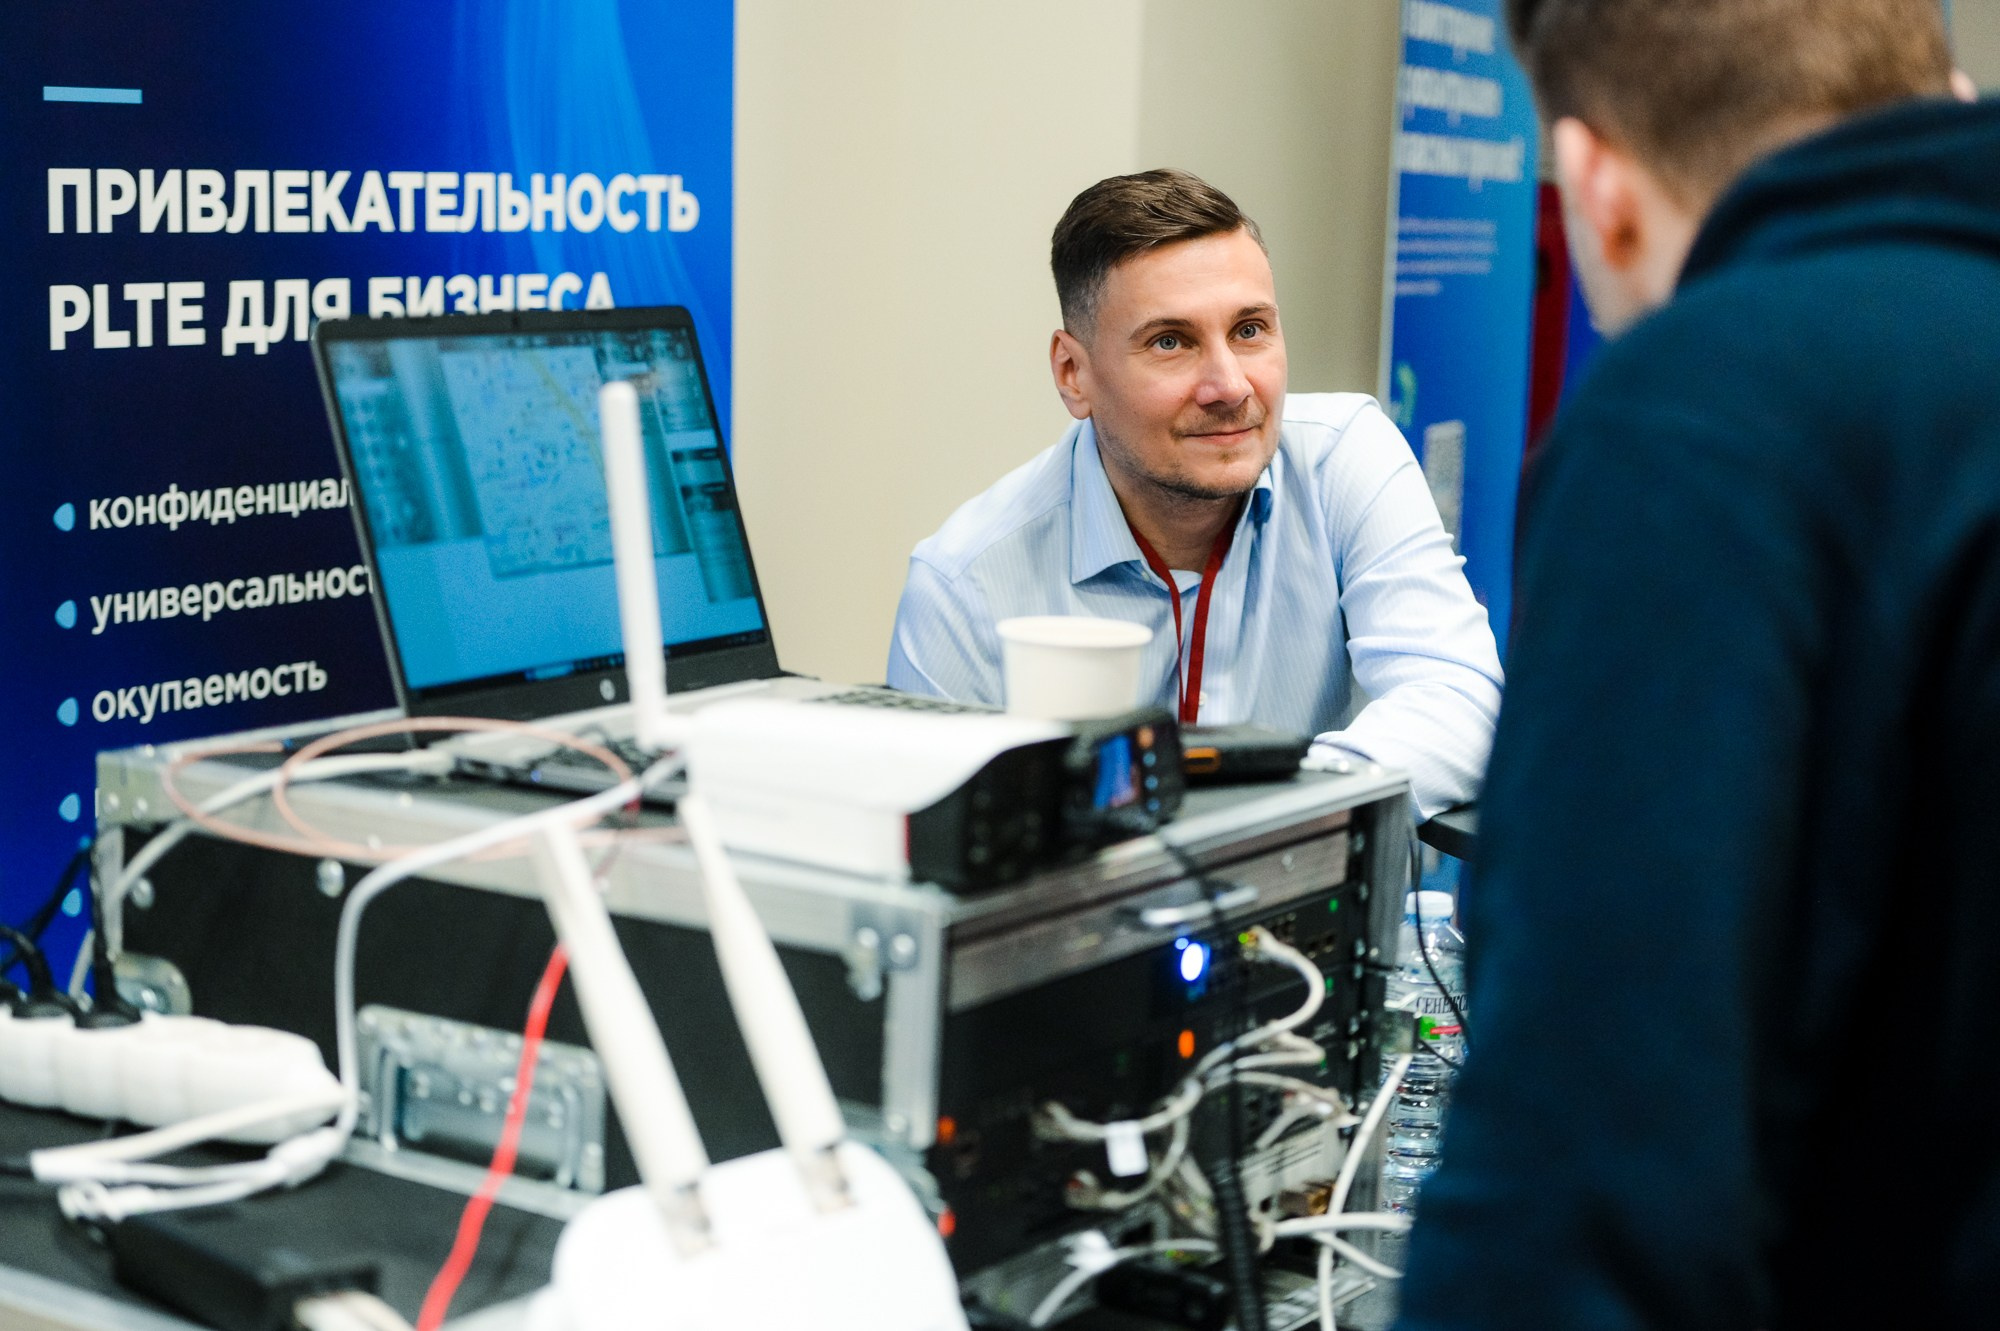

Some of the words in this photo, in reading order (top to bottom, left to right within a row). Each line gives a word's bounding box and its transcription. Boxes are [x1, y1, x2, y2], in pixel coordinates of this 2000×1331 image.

[47, 167, 700, 234] ПРИВЛЕКАТЕЛЬНОСТЬ
[48, 282, 206, 351] PLTE
[221, 277, 351, 356] ДЛЯ
[368, 271, 616, 319] БИЗНЕСА
[91, 660, 328, 724] окупаемость
